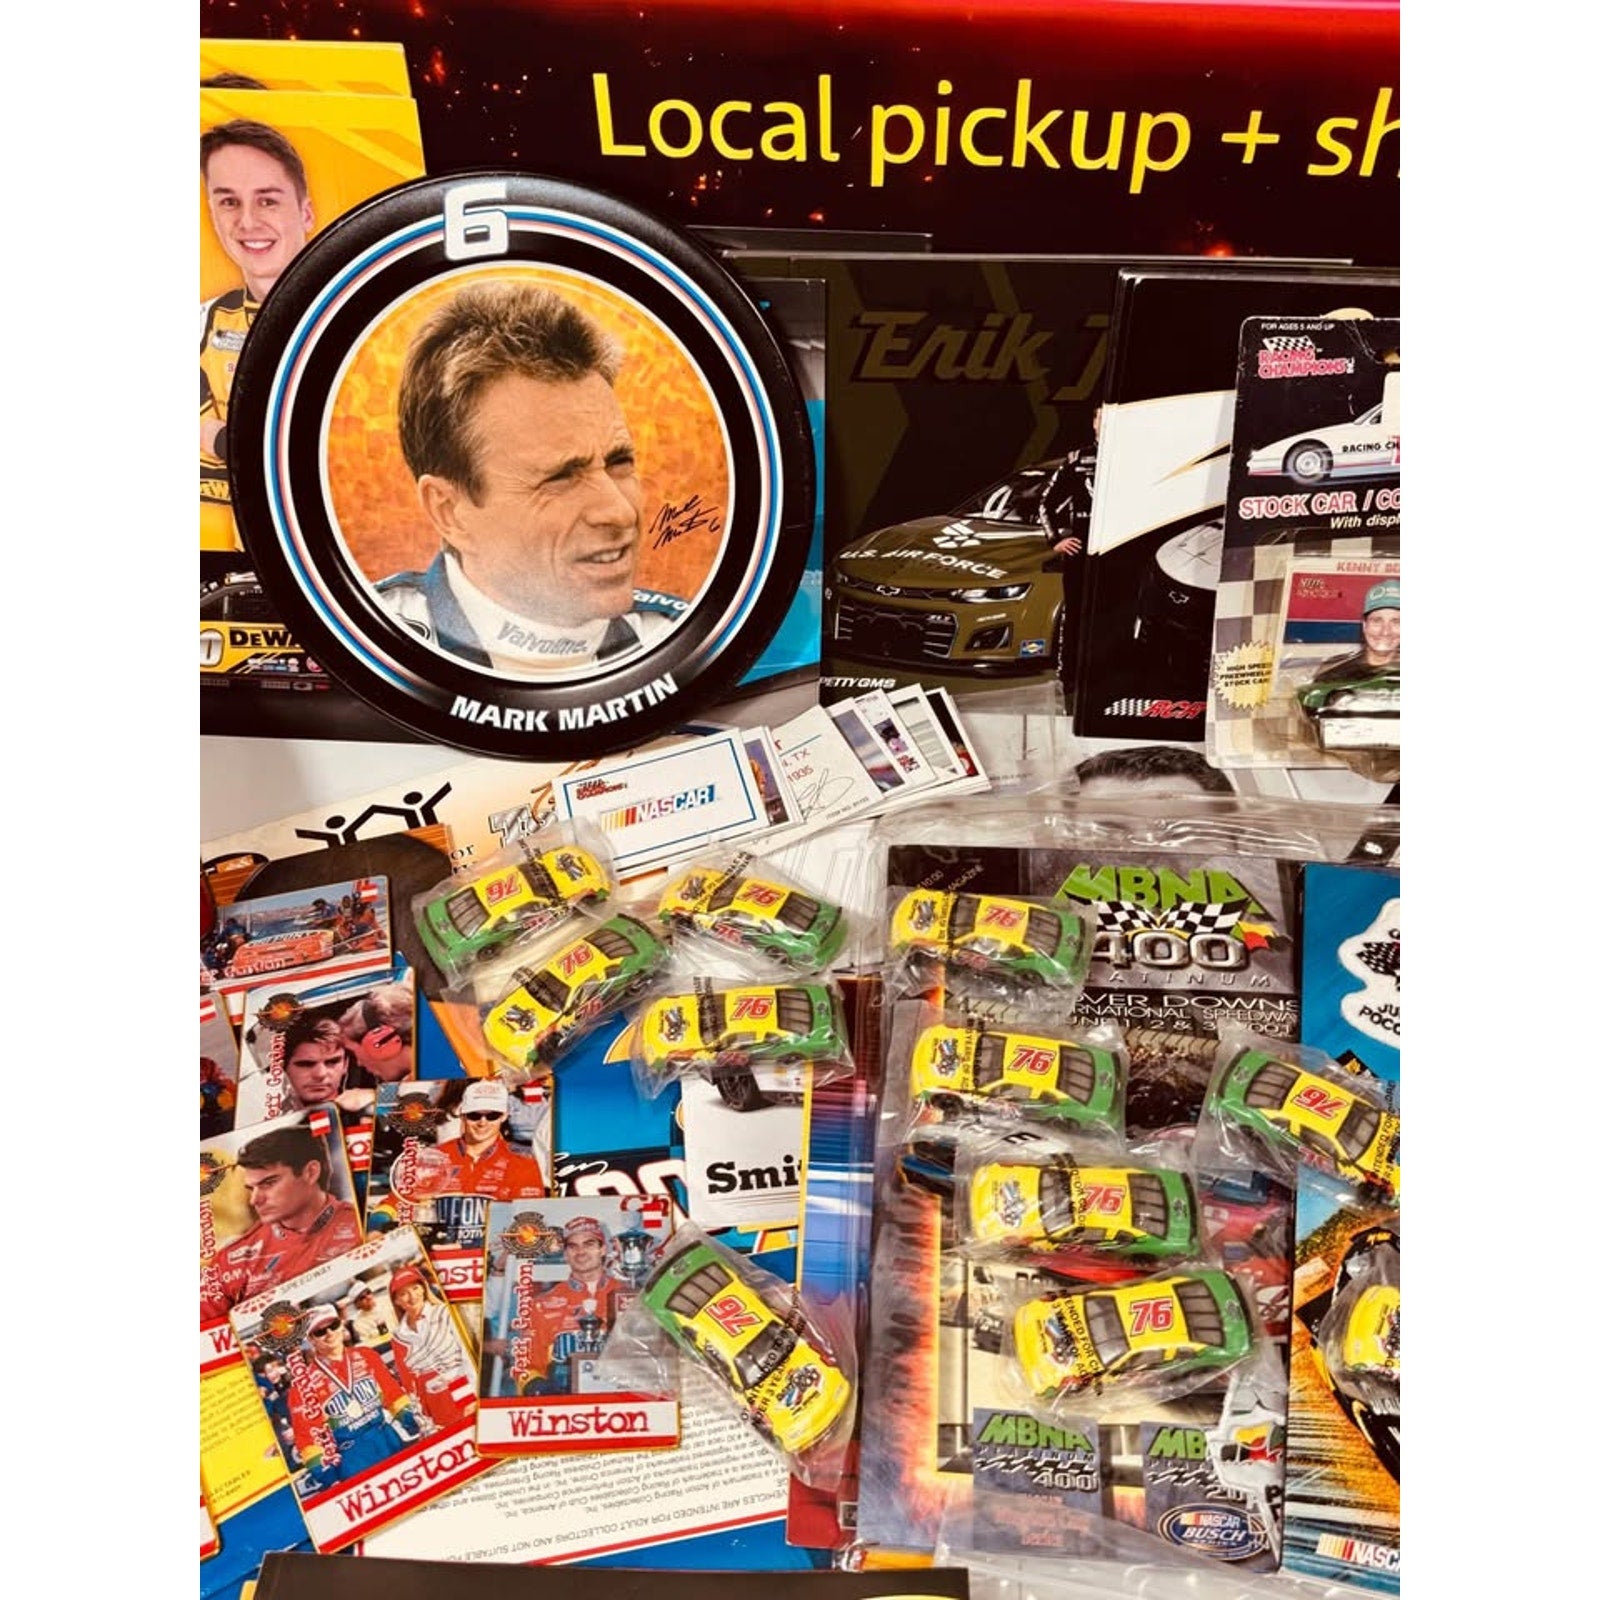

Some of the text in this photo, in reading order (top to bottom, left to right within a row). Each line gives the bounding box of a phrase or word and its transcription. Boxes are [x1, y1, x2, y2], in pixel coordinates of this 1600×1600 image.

[593, 73, 840, 162] Local
[871, 79, 1191, 194] pickup
[1221, 110, 1281, 164] +
[444, 183, 510, 261] 6
[1261, 323, 1277, 331] FOR
[1278, 323, 1298, 331] AGES
[1324, 322, 1336, 330] UP
[854, 311, 1053, 381] Erik
[1258, 358, 1347, 379] CHAMPIONS
[1342, 443, 1381, 453] RACING
[1238, 493, 1311, 519] STOCK
[1311, 491, 1359, 515] CAR
[1330, 517, 1362, 530] With
[839, 549, 1008, 580] U.S. AIR FORCE
[1336, 562, 1381, 573] KENNY
[496, 621, 587, 655] Valvoline
[1227, 664, 1246, 672] HIGH
[1224, 679, 1250, 688] STOCK
[449, 672, 679, 732] MARK MARTIN
[634, 784, 715, 823] NASCAR
[738, 884, 787, 907] 76
[1054, 864, 1268, 915] MBNA
[981, 904, 1026, 929] 76
[559, 944, 593, 978] 76
[1093, 929, 1248, 969] 400
[729, 994, 775, 1021] 76
[1150, 1019, 1165, 1030] 2
[1173, 1020, 1192, 1031] &
[266, 1032, 287, 1086] Gordon
[1008, 1044, 1056, 1075] 76
[707, 1154, 802, 1195] Smi
[1081, 1183, 1127, 1216] 76
[510, 1263, 534, 1381] Jeff Gordon
[1129, 1296, 1174, 1337] 76
[1078, 1335, 1096, 1358] FOR
[287, 1351, 323, 1419] Gordon
[508, 1406, 648, 1438] Winston
[977, 1412, 1093, 1453] MBNA
[336, 1439, 476, 1523] Winston
[1032, 1468, 1100, 1492] 400
[619, 1515, 650, 1530] ADULT
[650, 1511, 671, 1524] FOR
[672, 1501, 719, 1519] INTENDED
[1199, 1514, 1242, 1529] NASCAR
[510, 1539, 531, 1552] NOT
[532, 1535, 553, 1548] AND
[554, 1521, 618, 1544] COLLECTORS
[1183, 1527, 1246, 1543] BUSCH
